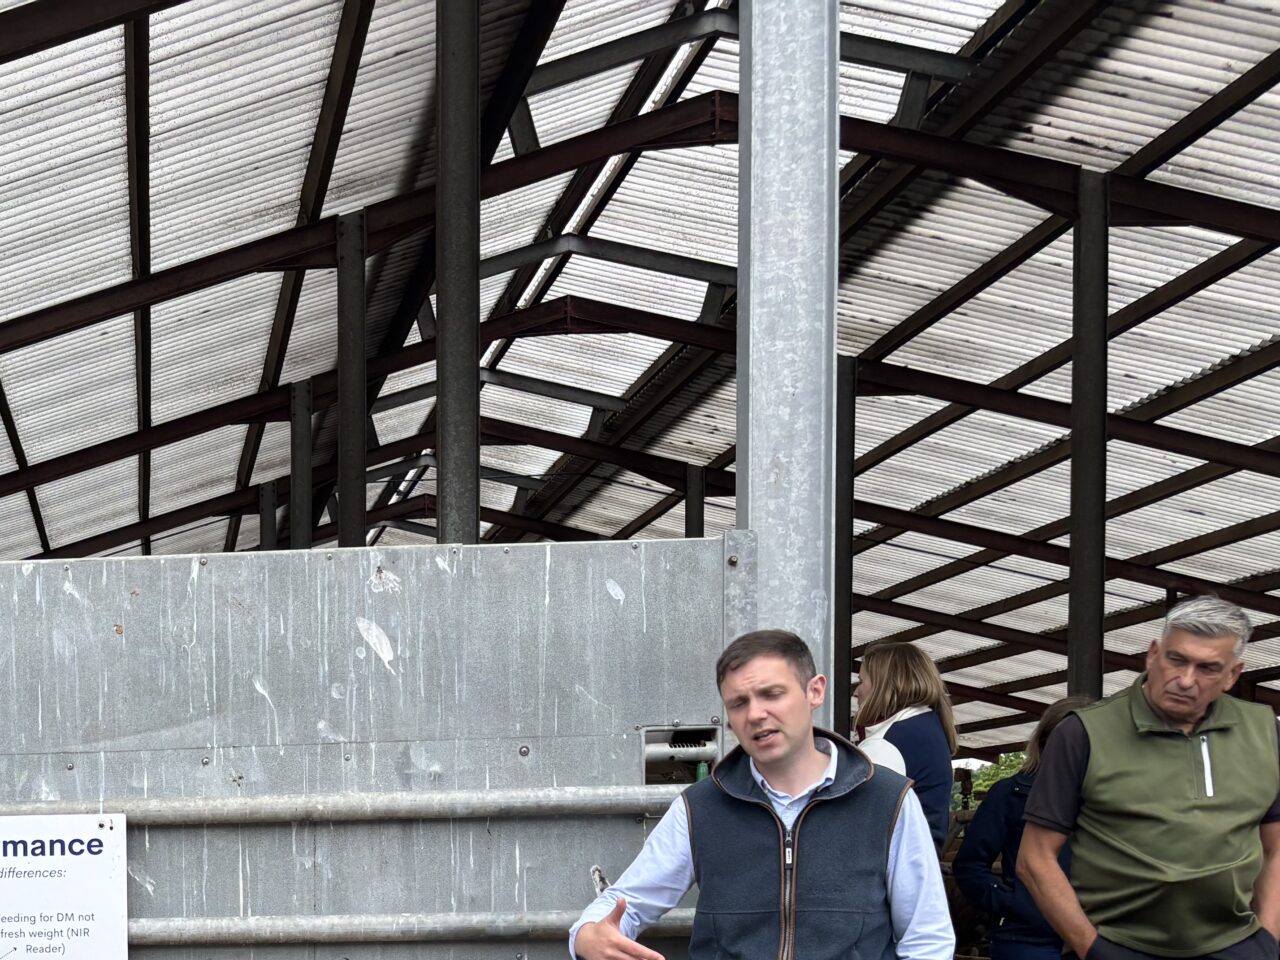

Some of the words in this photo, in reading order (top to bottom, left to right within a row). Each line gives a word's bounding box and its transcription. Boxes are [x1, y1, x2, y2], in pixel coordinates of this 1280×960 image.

[39, 912, 53, 922] for
[56, 913, 75, 921] DM
[78, 913, 95, 921] not
[0, 929, 26, 938] fresh
[29, 928, 63, 940] weight
[67, 928, 90, 939] (NIR
[26, 944, 65, 955] Reader)
